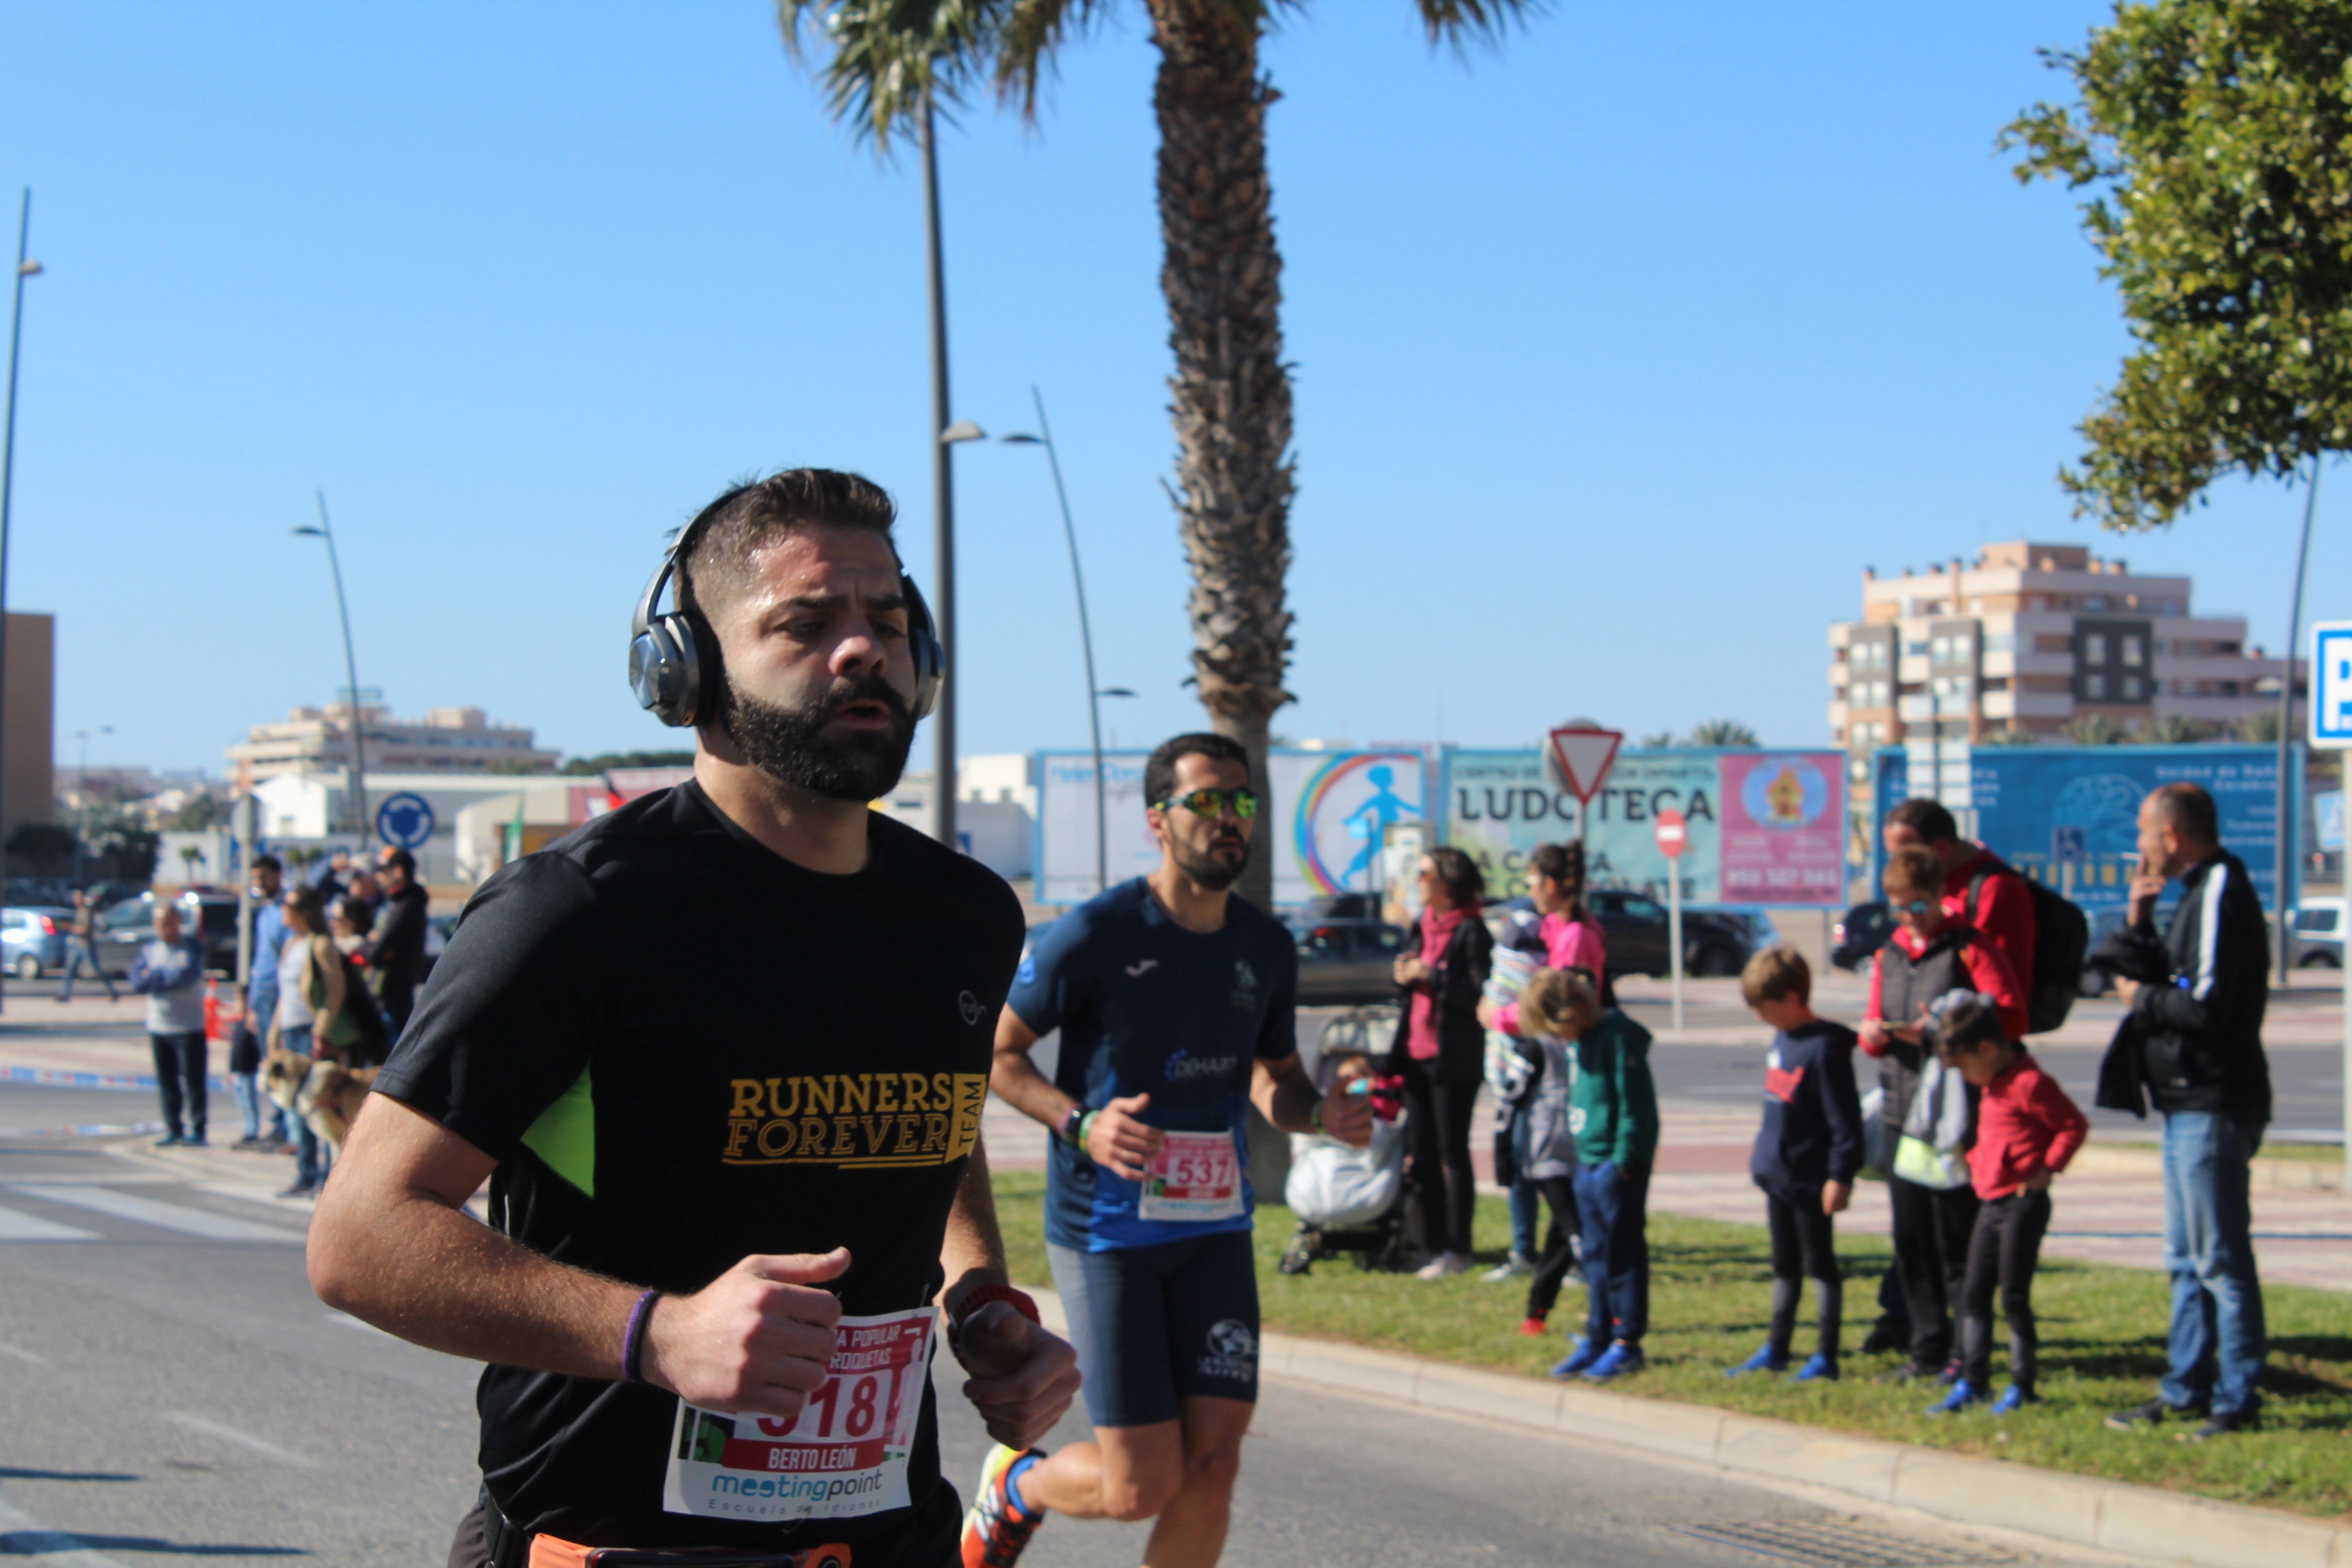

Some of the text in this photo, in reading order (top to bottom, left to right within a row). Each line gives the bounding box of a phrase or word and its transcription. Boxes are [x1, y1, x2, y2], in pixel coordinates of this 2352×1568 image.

[1458, 787, 1714, 821] LUDOTECA
[730, 1073, 953, 1117] RUNNERS
[957, 1080, 982, 1148] TEAM
[723, 1113, 950, 1157] FOREVER
[1177, 1158, 1230, 1184] 537
[851, 1324, 900, 1347] POPULAR
[829, 1348, 892, 1369] ROQUETAS
[768, 1444, 858, 1470] BERTO LEÓN
[711, 1468, 883, 1501] meetingpoint
[708, 1499, 785, 1514] Escuela
